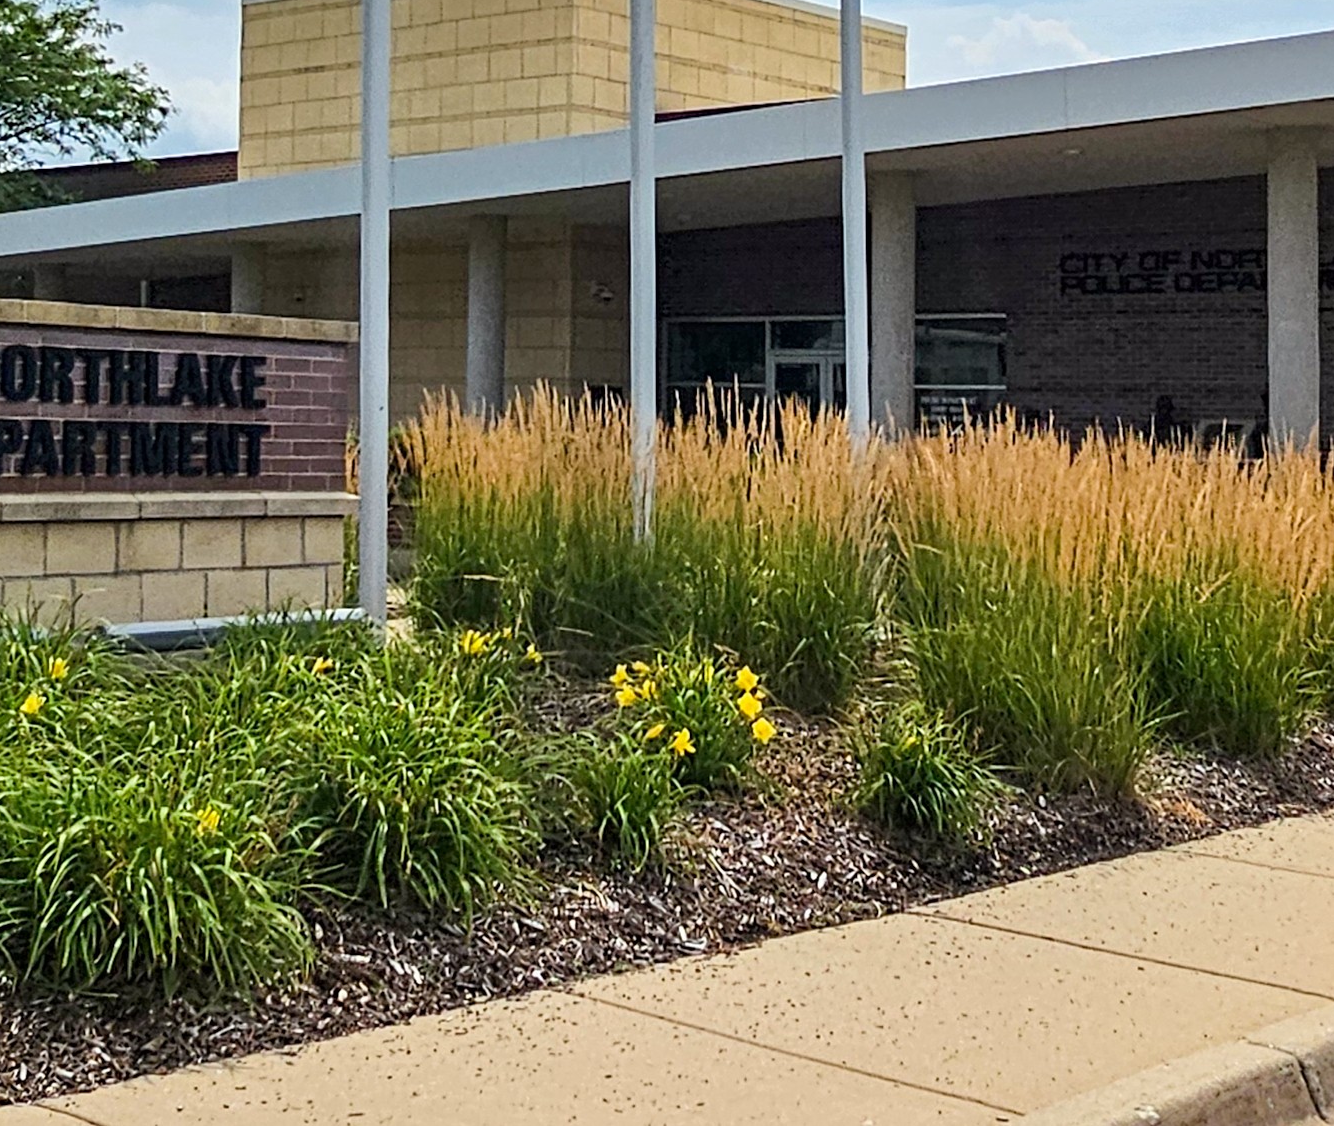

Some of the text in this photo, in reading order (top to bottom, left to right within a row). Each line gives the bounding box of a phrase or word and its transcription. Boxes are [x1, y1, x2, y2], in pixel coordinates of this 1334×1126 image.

[1060, 252, 1128, 273] CITY
[1139, 251, 1183, 271] OF
[1061, 274, 1166, 295] POLICE
